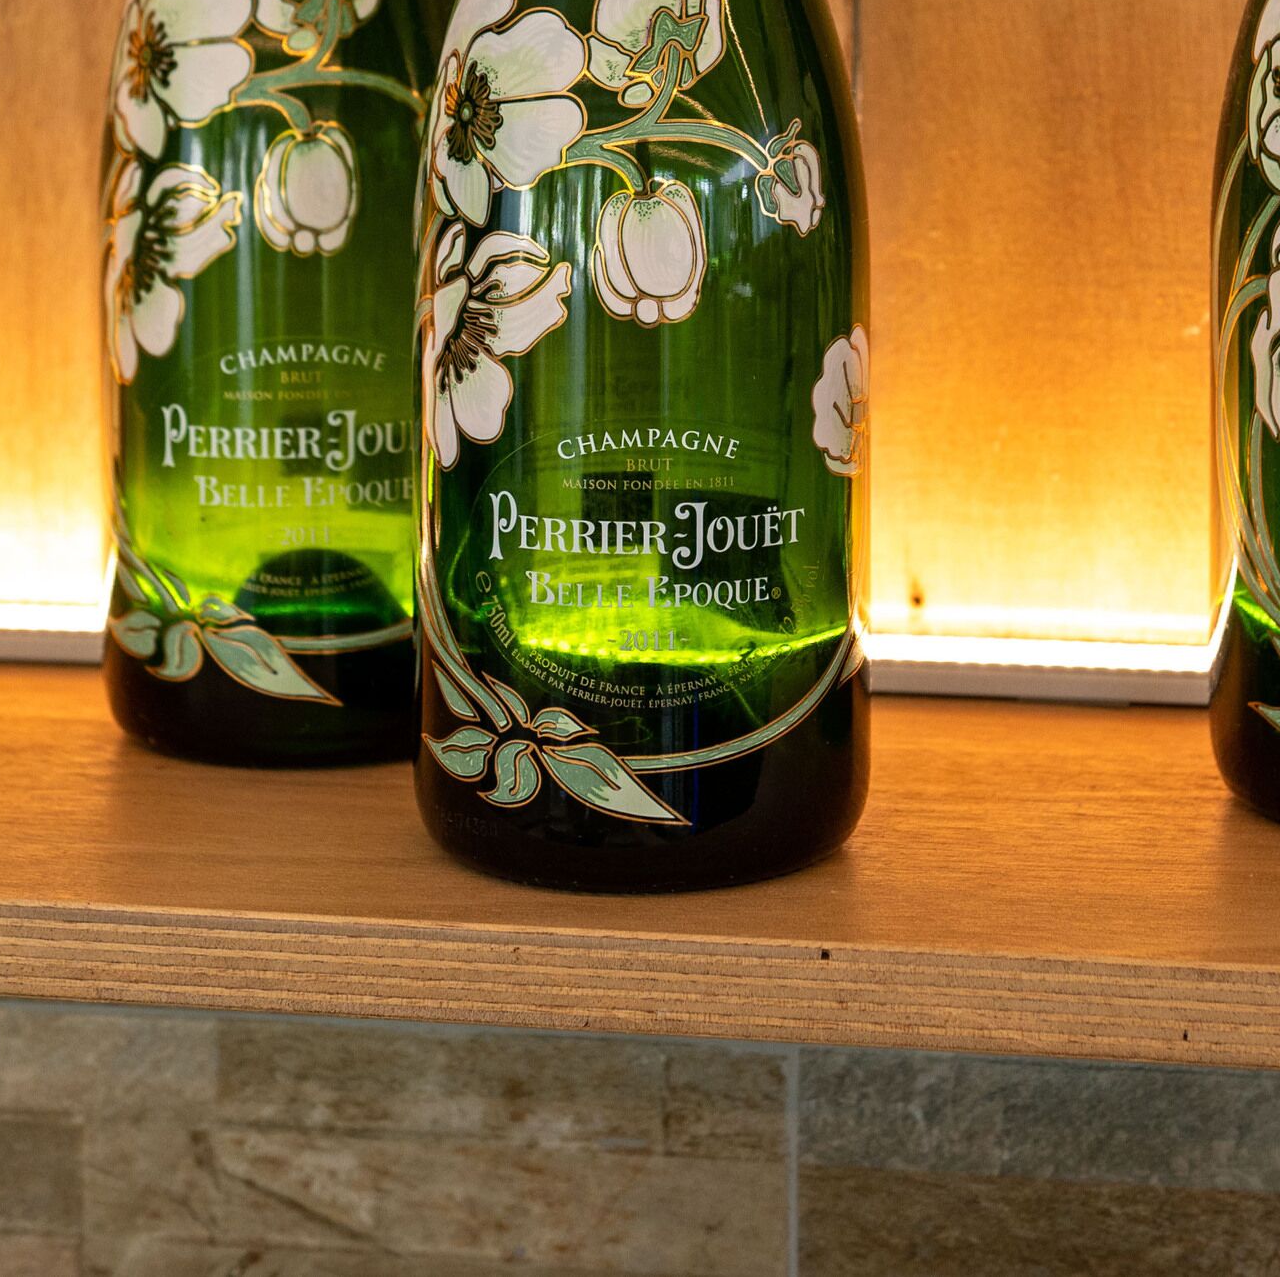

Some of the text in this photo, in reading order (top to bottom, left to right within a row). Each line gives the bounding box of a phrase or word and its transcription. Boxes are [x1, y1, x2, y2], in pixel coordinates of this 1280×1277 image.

[220, 343, 387, 375] CHAMPAGNE
[280, 371, 321, 385] BRUT
[161, 403, 414, 471] PERRIER-JOU
[557, 428, 740, 459] CHAMPAGNE
[562, 478, 617, 490] MAISON
[686, 478, 703, 489] EN
[709, 476, 735, 488] 1811
[626, 458, 674, 472] BRUT
[194, 475, 291, 508] BELLE
[488, 490, 805, 570] PERRIER-JOUËT
[525, 570, 633, 609] BELLE
[481, 595, 518, 649] 750ml
[511, 648, 547, 681] ÉLABORÉ
[548, 675, 566, 692] PAR
[529, 648, 578, 682] PRODUIT
[580, 675, 596, 690] DE
[599, 680, 646, 696] FRANCE
[667, 674, 718, 695] ÉPERNAY
